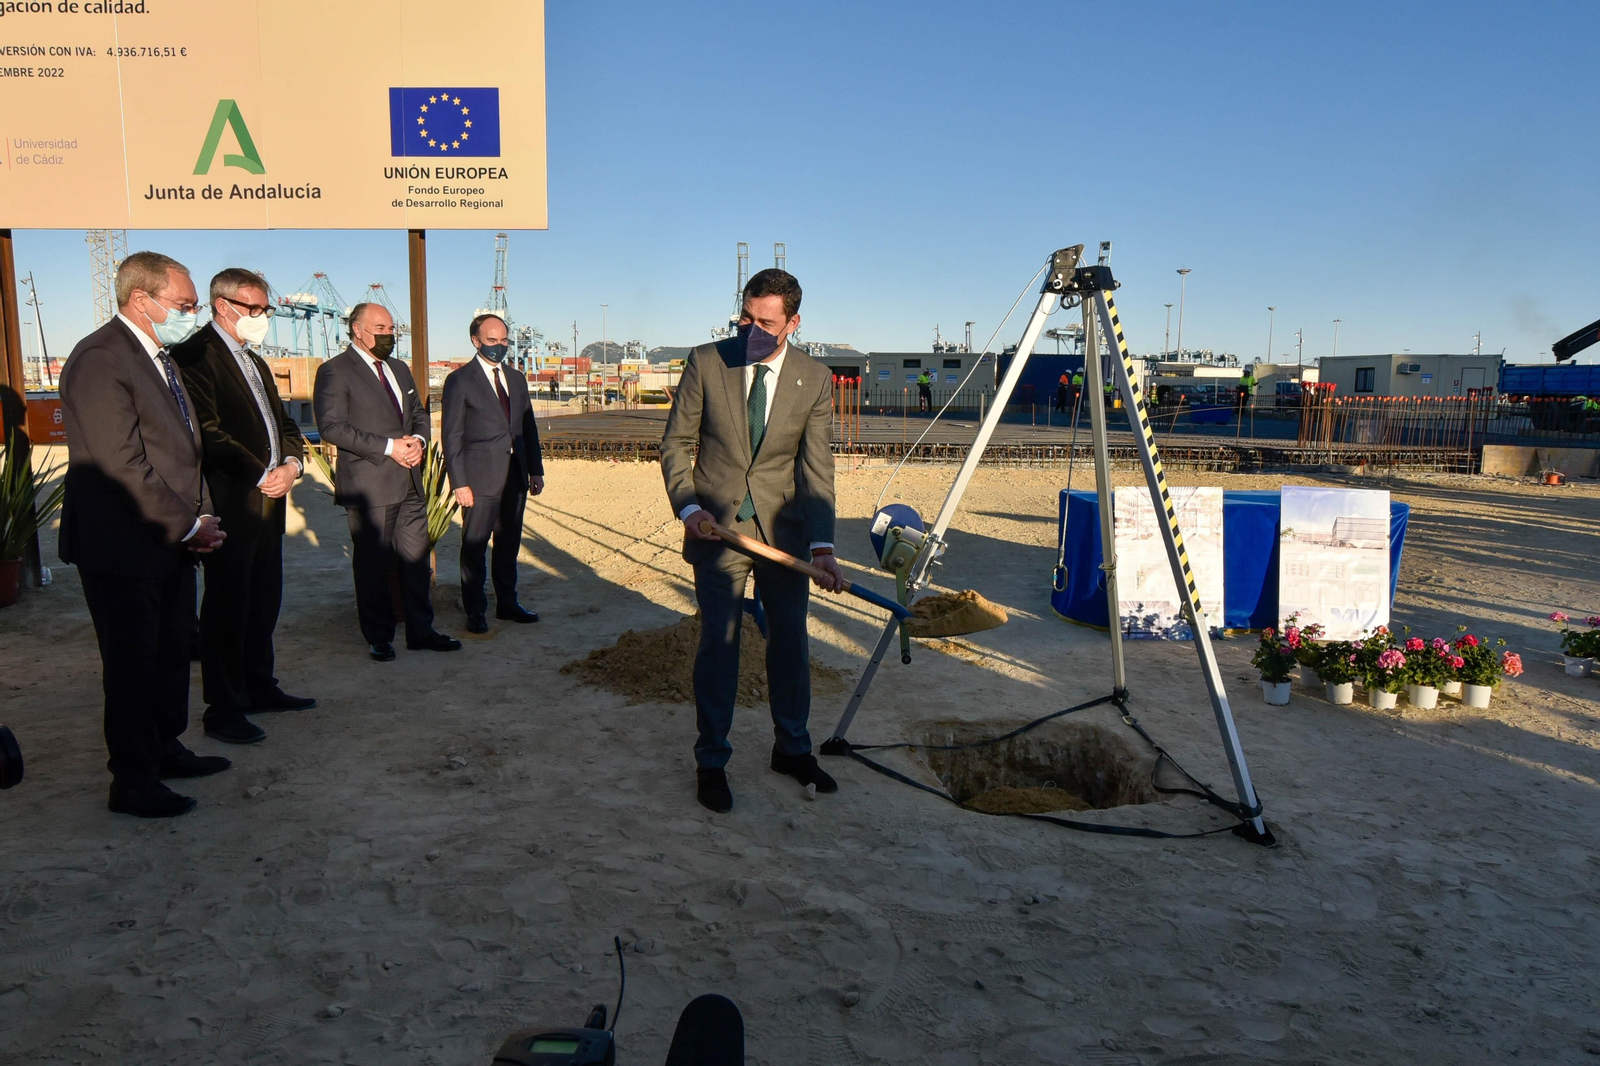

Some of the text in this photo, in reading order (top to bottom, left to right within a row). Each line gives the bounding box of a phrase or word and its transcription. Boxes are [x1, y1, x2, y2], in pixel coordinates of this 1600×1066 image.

[57, 0, 79, 14] de
[84, 0, 150, 14] calidad.
[49, 46, 72, 57] CON
[75, 46, 97, 57] IVA:
[106, 46, 177, 58] 4.936.716,51
[179, 47, 188, 58] €
[37, 67, 65, 78] 2022
[13, 138, 79, 150] Universidad
[15, 154, 30, 165] de
[32, 153, 65, 165] Cádiz
[383, 163, 509, 180] UNIÓN EUROPEA
[143, 182, 322, 201] Junta de Andalucía
[407, 185, 486, 197] Fondo Europeo
[391, 198, 504, 211] de Desarrollo Regional
